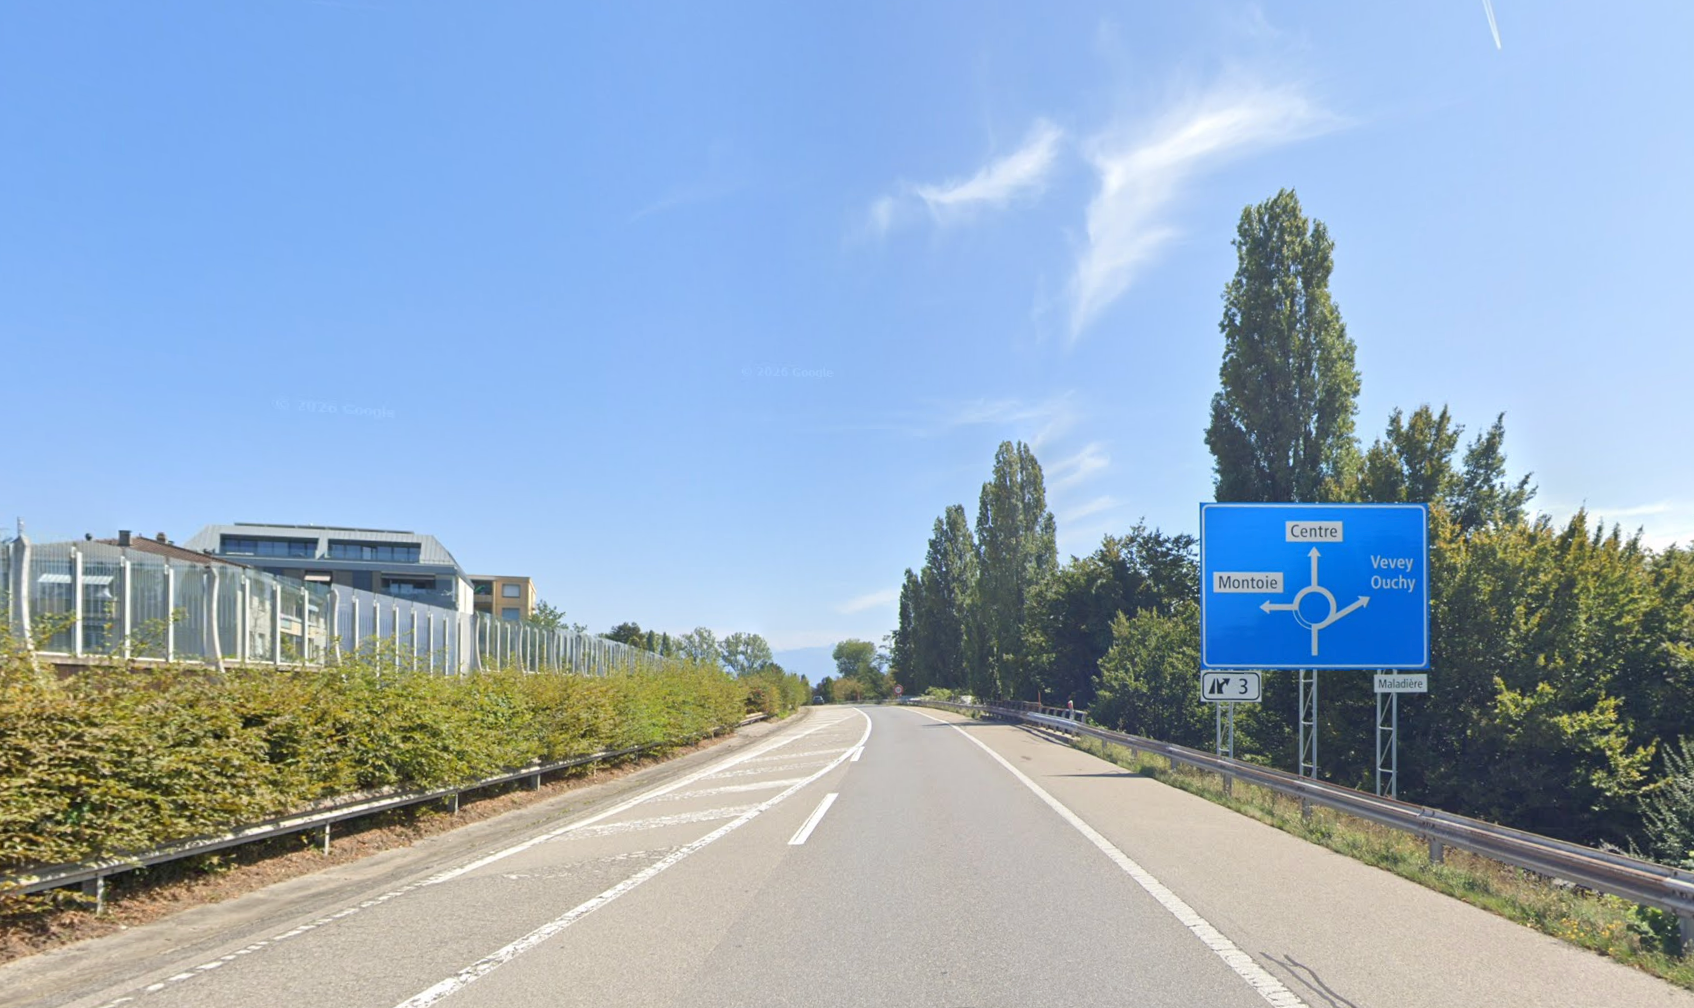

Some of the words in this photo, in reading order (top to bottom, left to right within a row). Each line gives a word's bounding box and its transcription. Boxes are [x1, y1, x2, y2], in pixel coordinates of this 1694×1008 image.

[1290, 524, 1338, 538] Centre
[1370, 554, 1414, 573] Vevey
[1218, 575, 1278, 589] Montoie
[1370, 575, 1416, 593] Ouchy
[1238, 678, 1248, 694] 3
[1378, 678, 1423, 689] Maladière
